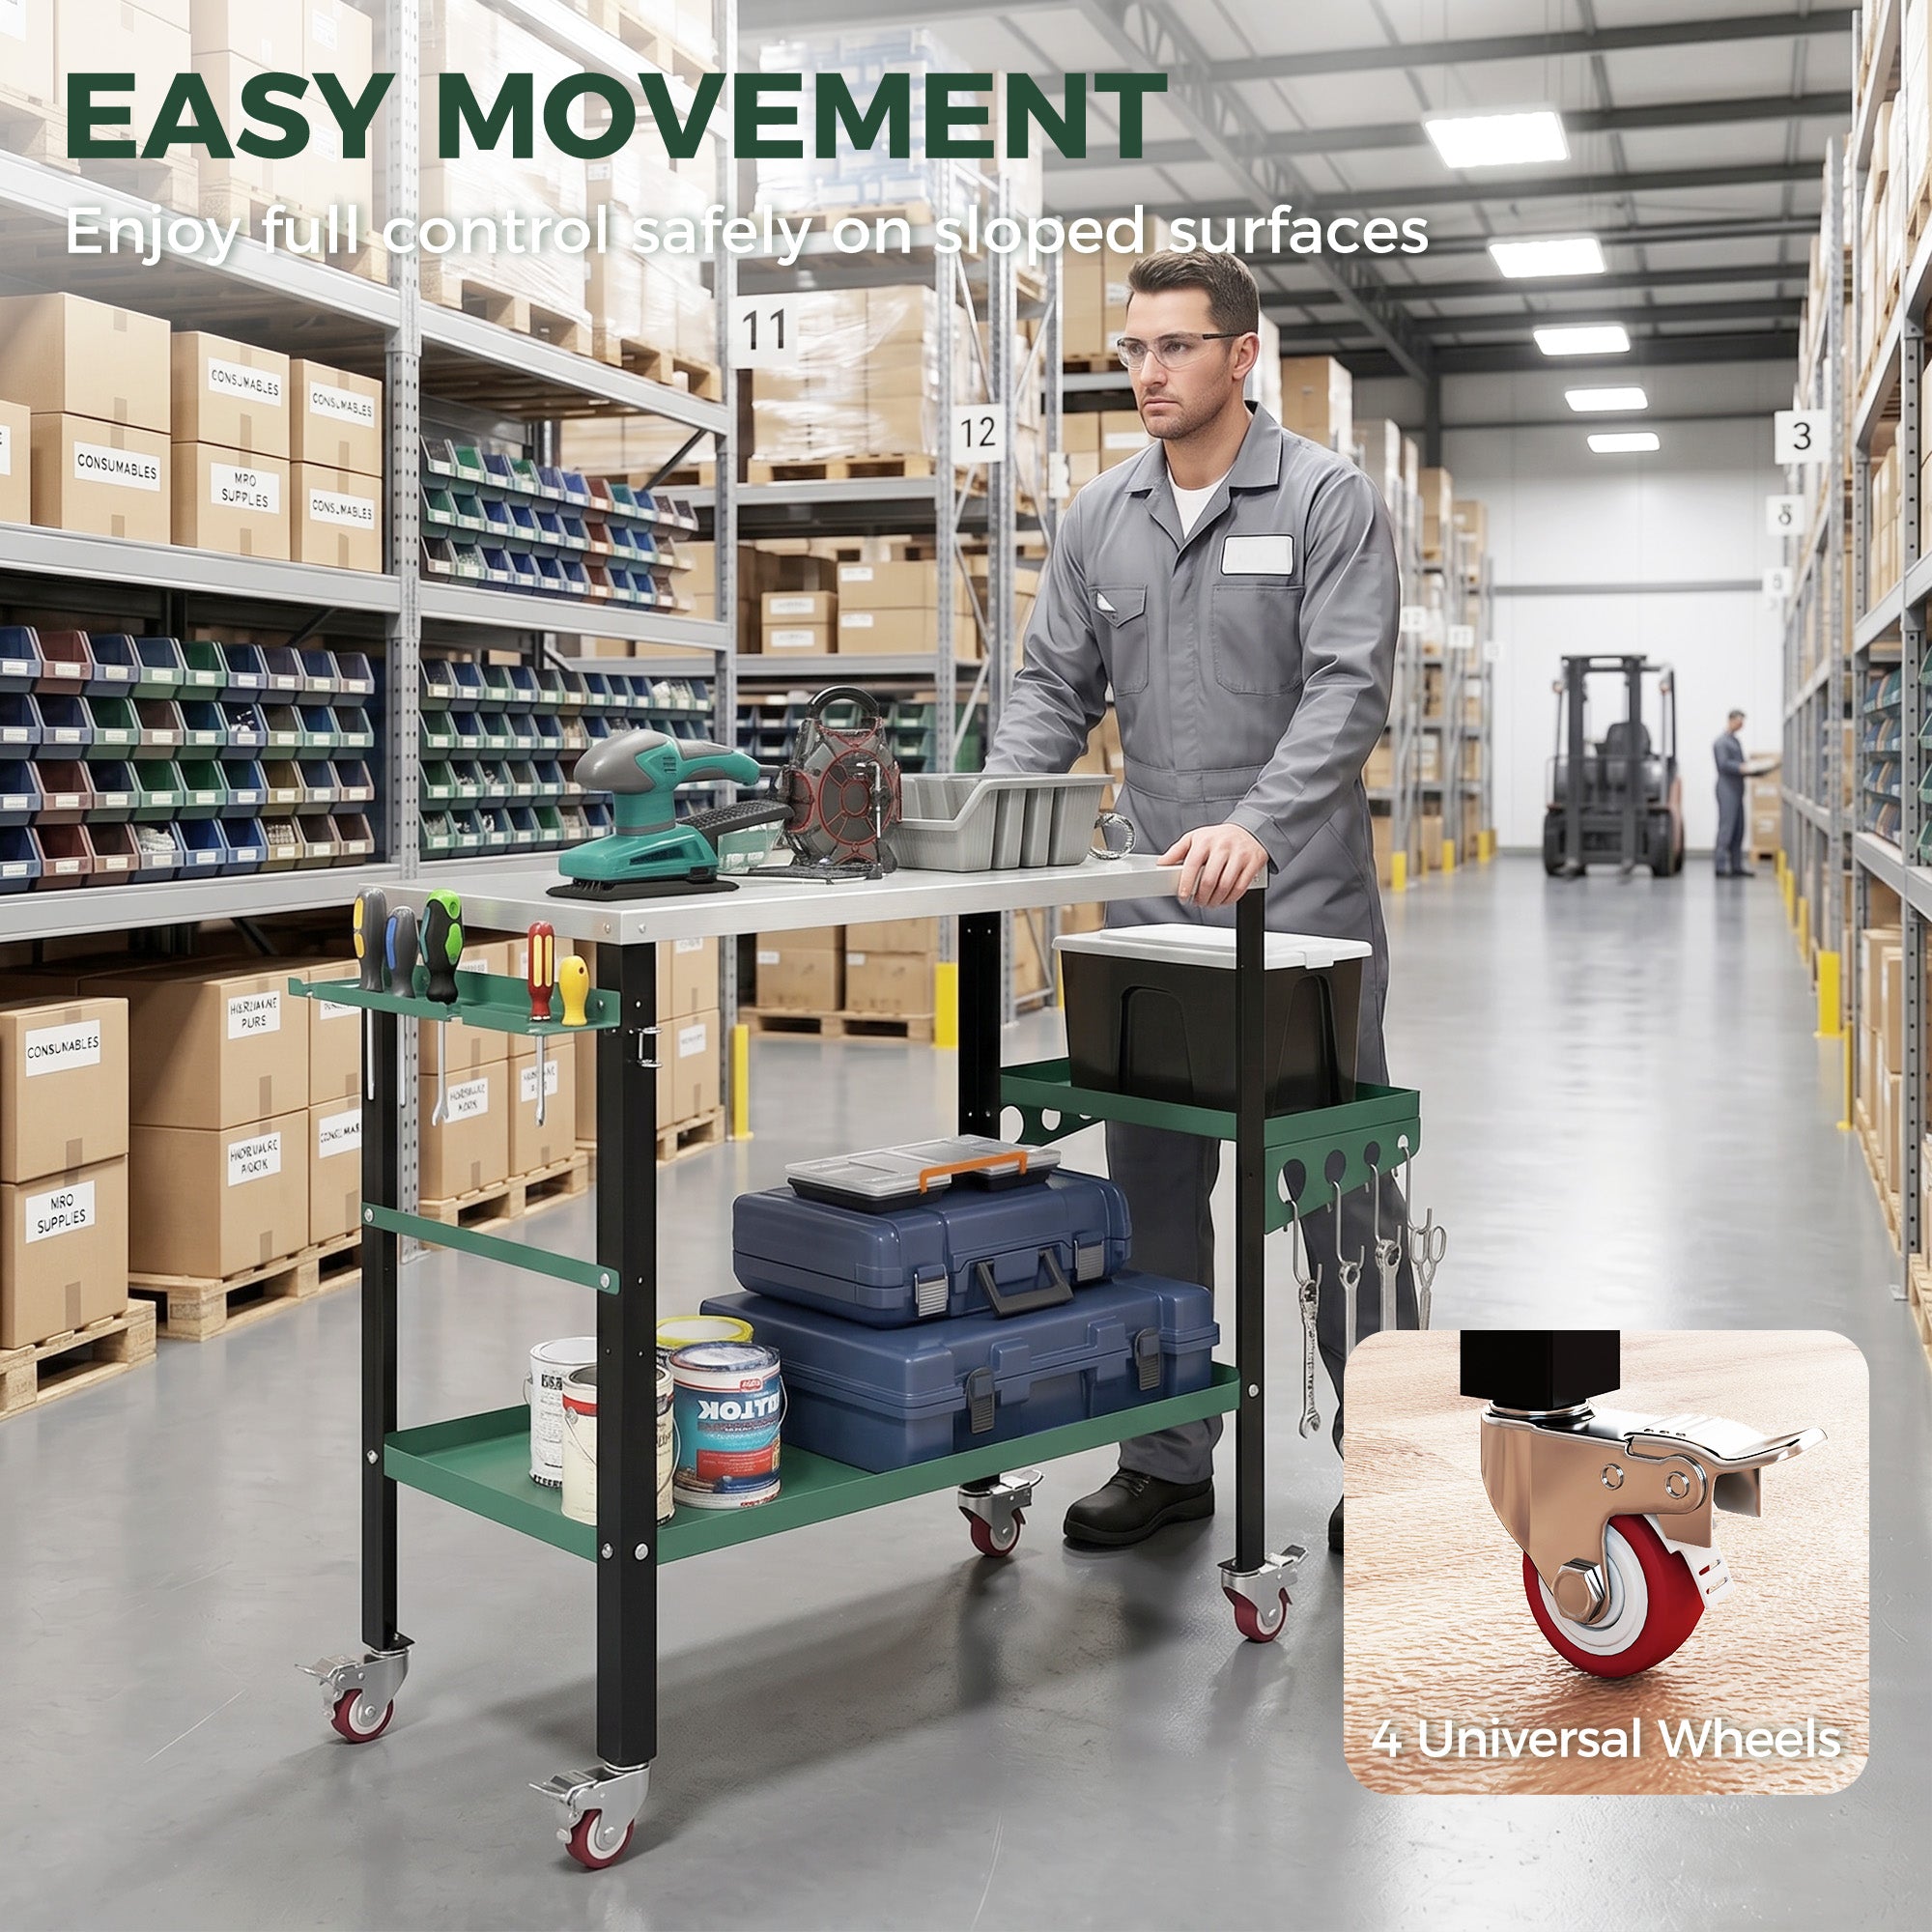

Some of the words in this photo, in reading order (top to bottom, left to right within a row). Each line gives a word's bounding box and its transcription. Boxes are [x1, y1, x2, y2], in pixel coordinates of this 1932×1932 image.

[742, 308, 785, 351] 11
[960, 415, 996, 448] 12
[1793, 422, 1811, 450] 3
[77, 453, 157, 480] CONSUMABLES
[50, 1193, 74, 1210] MRO
[37, 1208, 86, 1235] SUPPLIES
